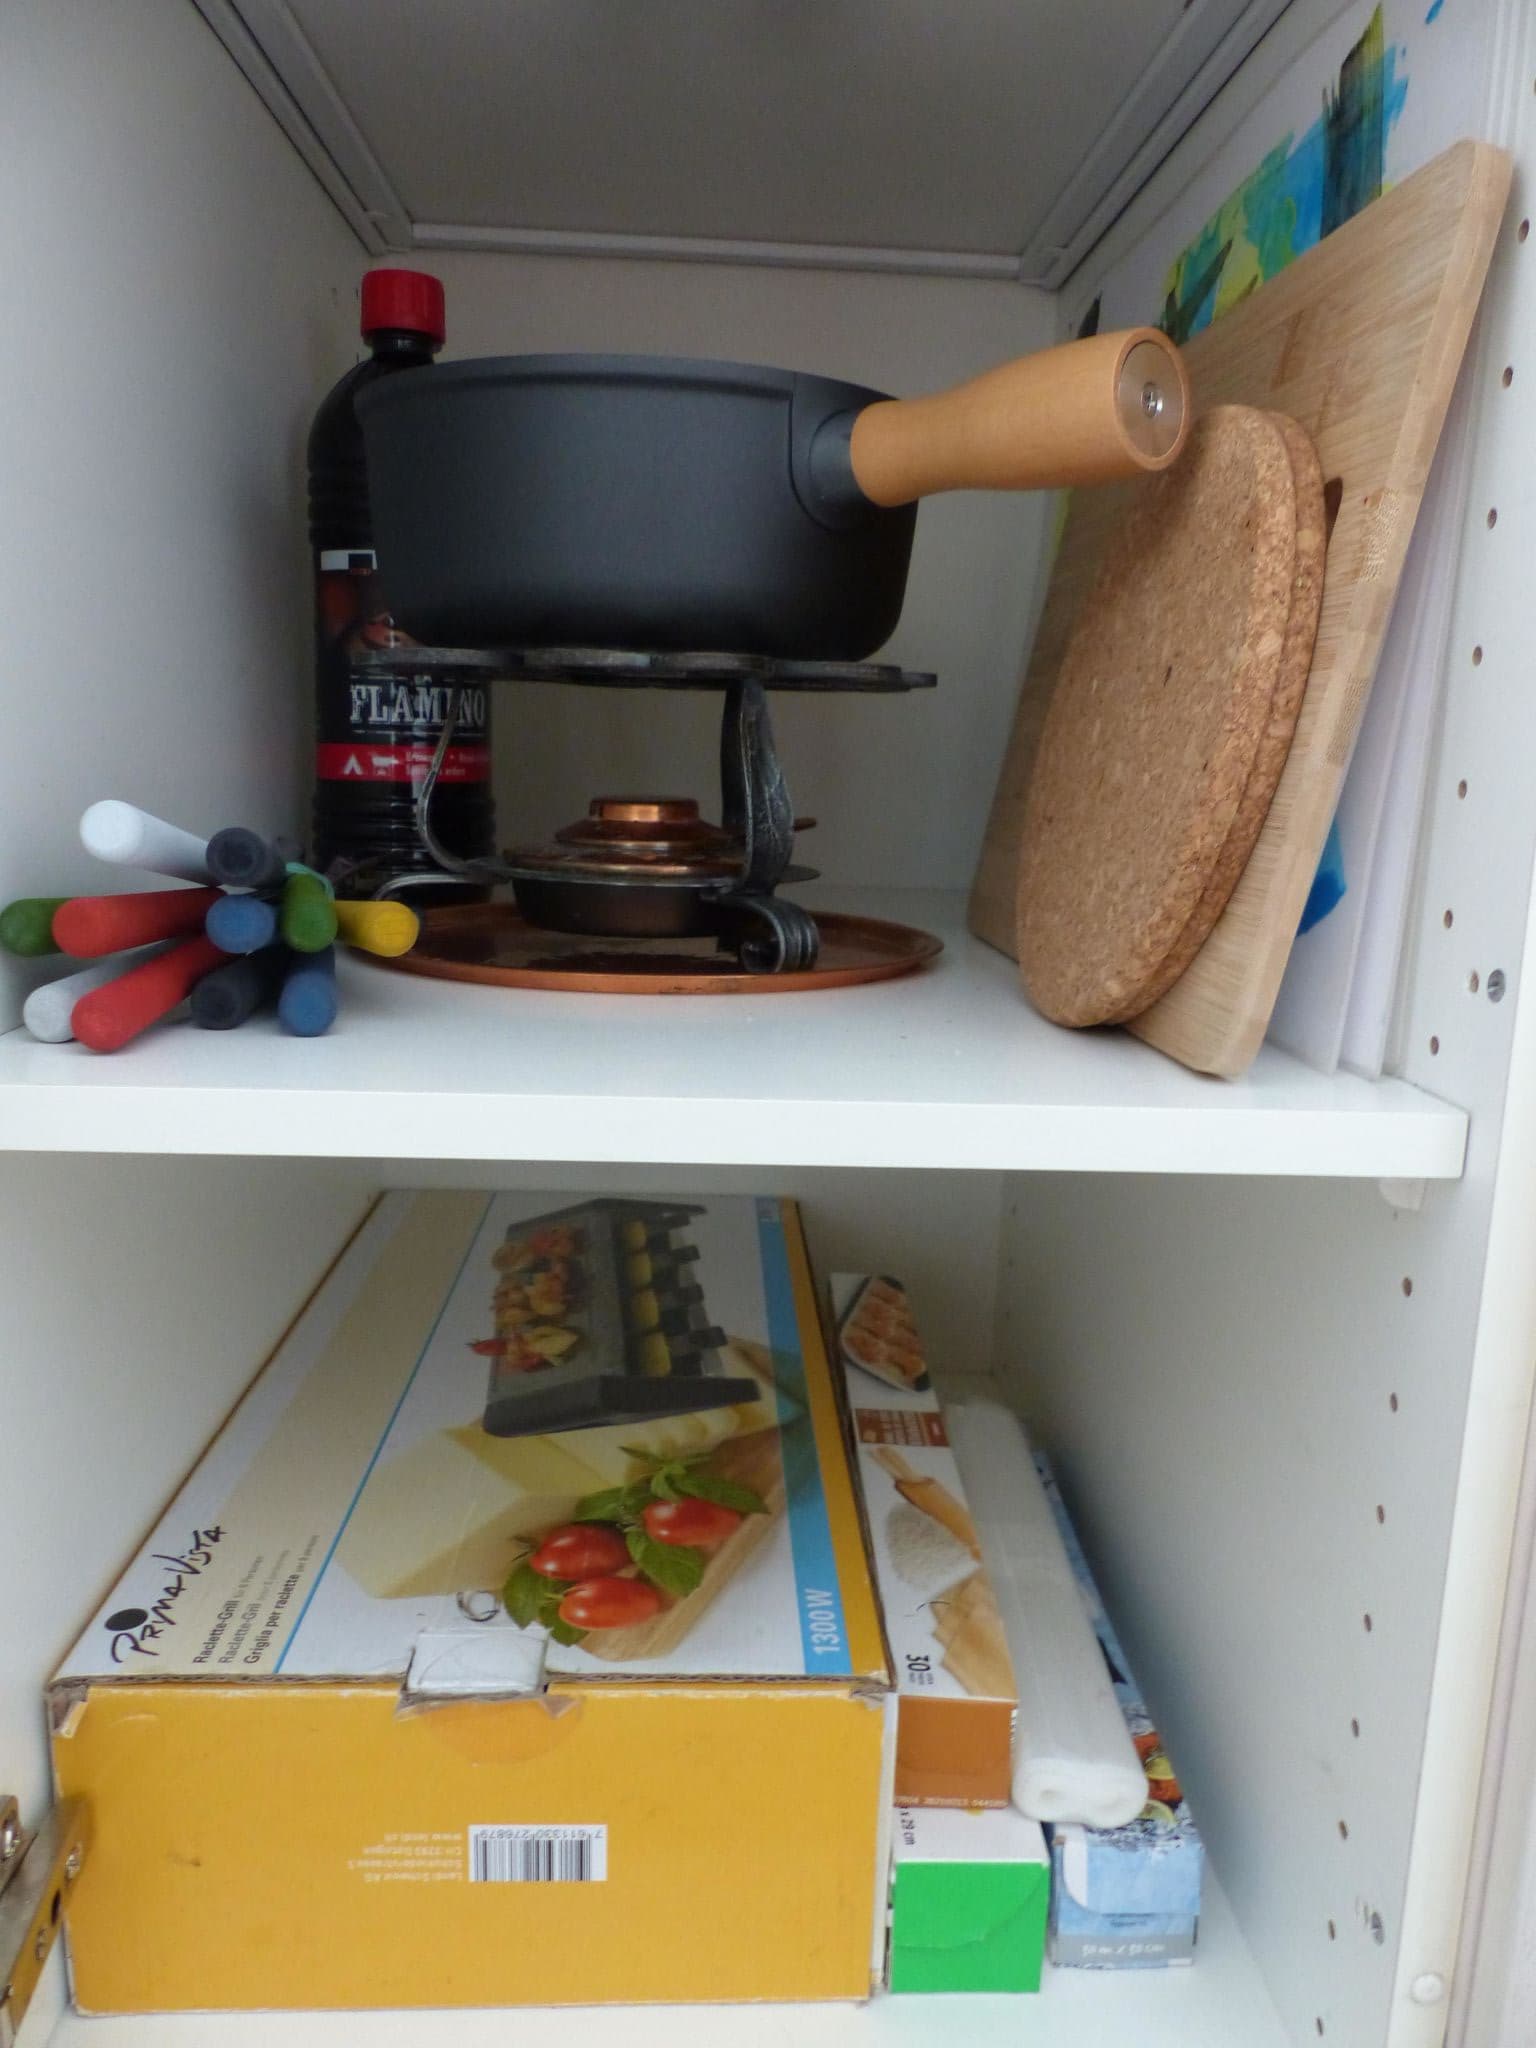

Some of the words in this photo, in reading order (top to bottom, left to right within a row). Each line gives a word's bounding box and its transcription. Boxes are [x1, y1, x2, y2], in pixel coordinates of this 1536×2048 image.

[349, 685, 485, 727] FLAMINO
[243, 1630, 272, 1664] Griglia
[266, 1612, 281, 1628] per
[275, 1575, 300, 1609] raclette
[804, 1588, 834, 1608] W
[193, 1601, 240, 1663] Raclette-Grill
[808, 1610, 841, 1655] 1300
[905, 1654, 931, 1672] 30
